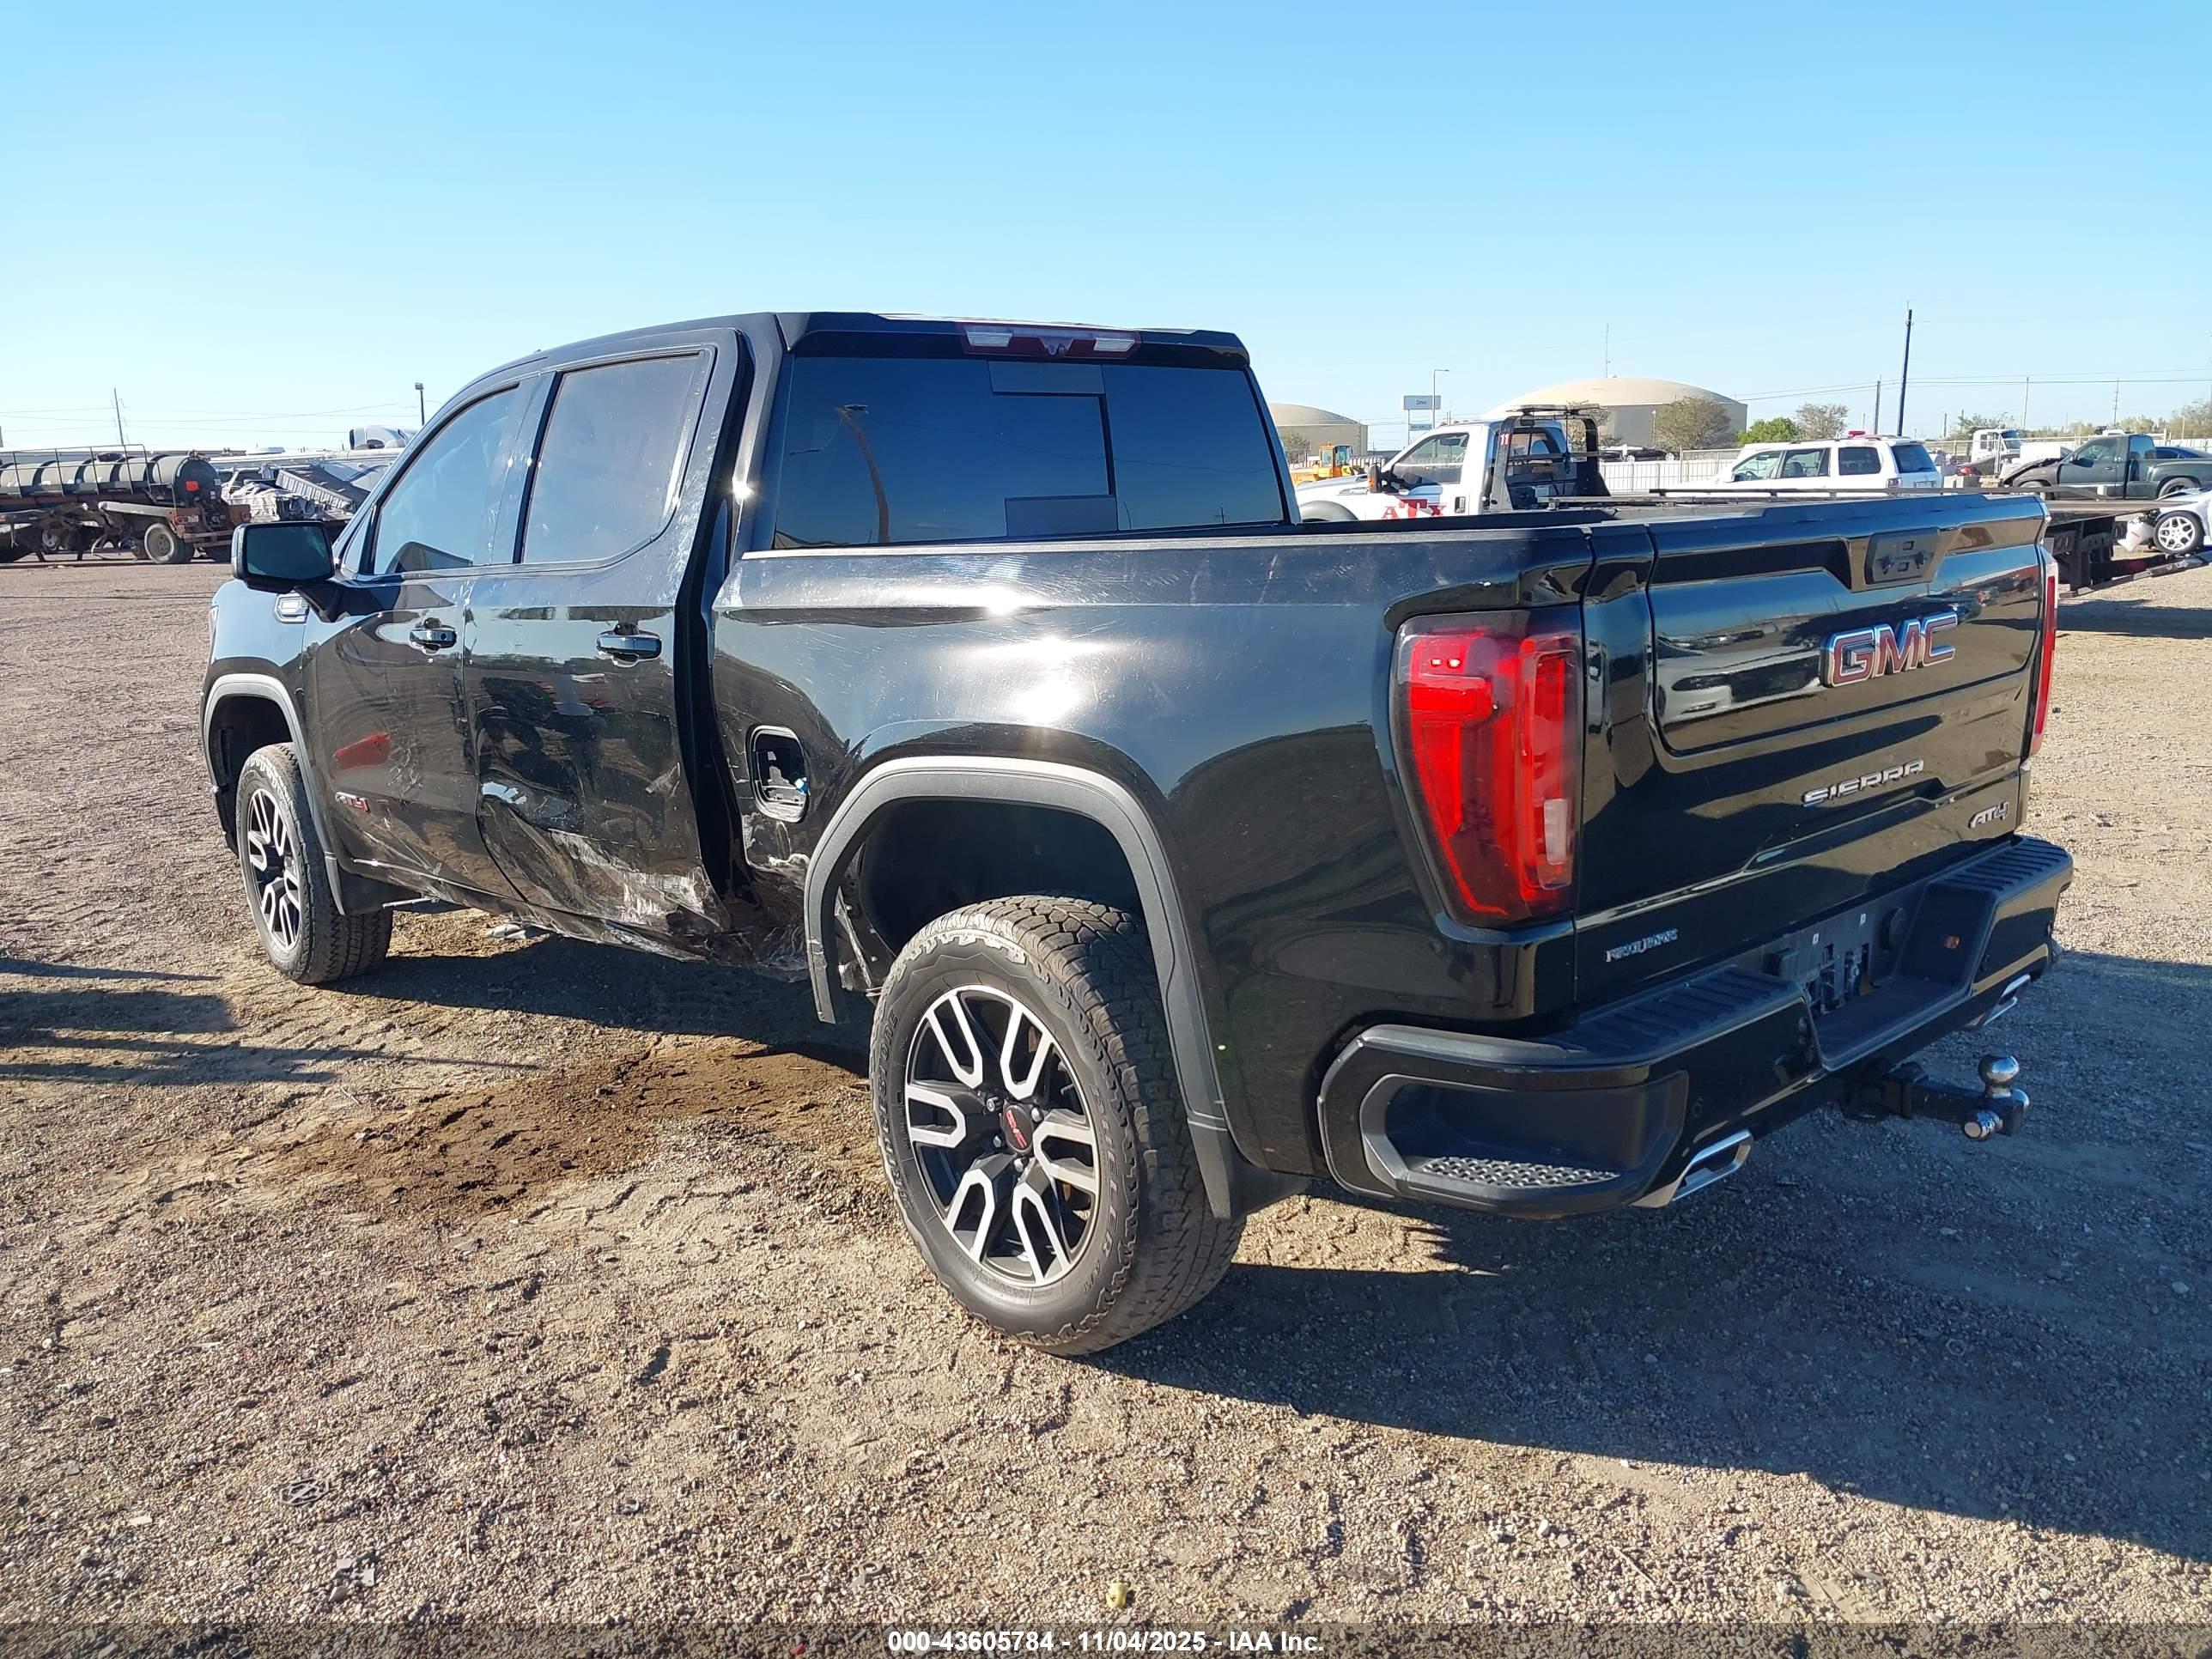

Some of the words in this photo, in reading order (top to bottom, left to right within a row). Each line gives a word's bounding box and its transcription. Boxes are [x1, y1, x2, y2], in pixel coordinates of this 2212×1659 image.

[1500, 433, 1510, 446] 11
[1381, 499, 1448, 520] ATX
[1822, 611, 1959, 688] GMC
[336, 791, 370, 813] AT4
[1803, 759, 1924, 806] SIERRA
[1969, 801, 2010, 830] AT4
[878, 1009, 912, 1211] BRIDGESTONE
[1006, 1109, 1028, 1149] GMC
[1088, 1084, 1119, 1259] DUELER
